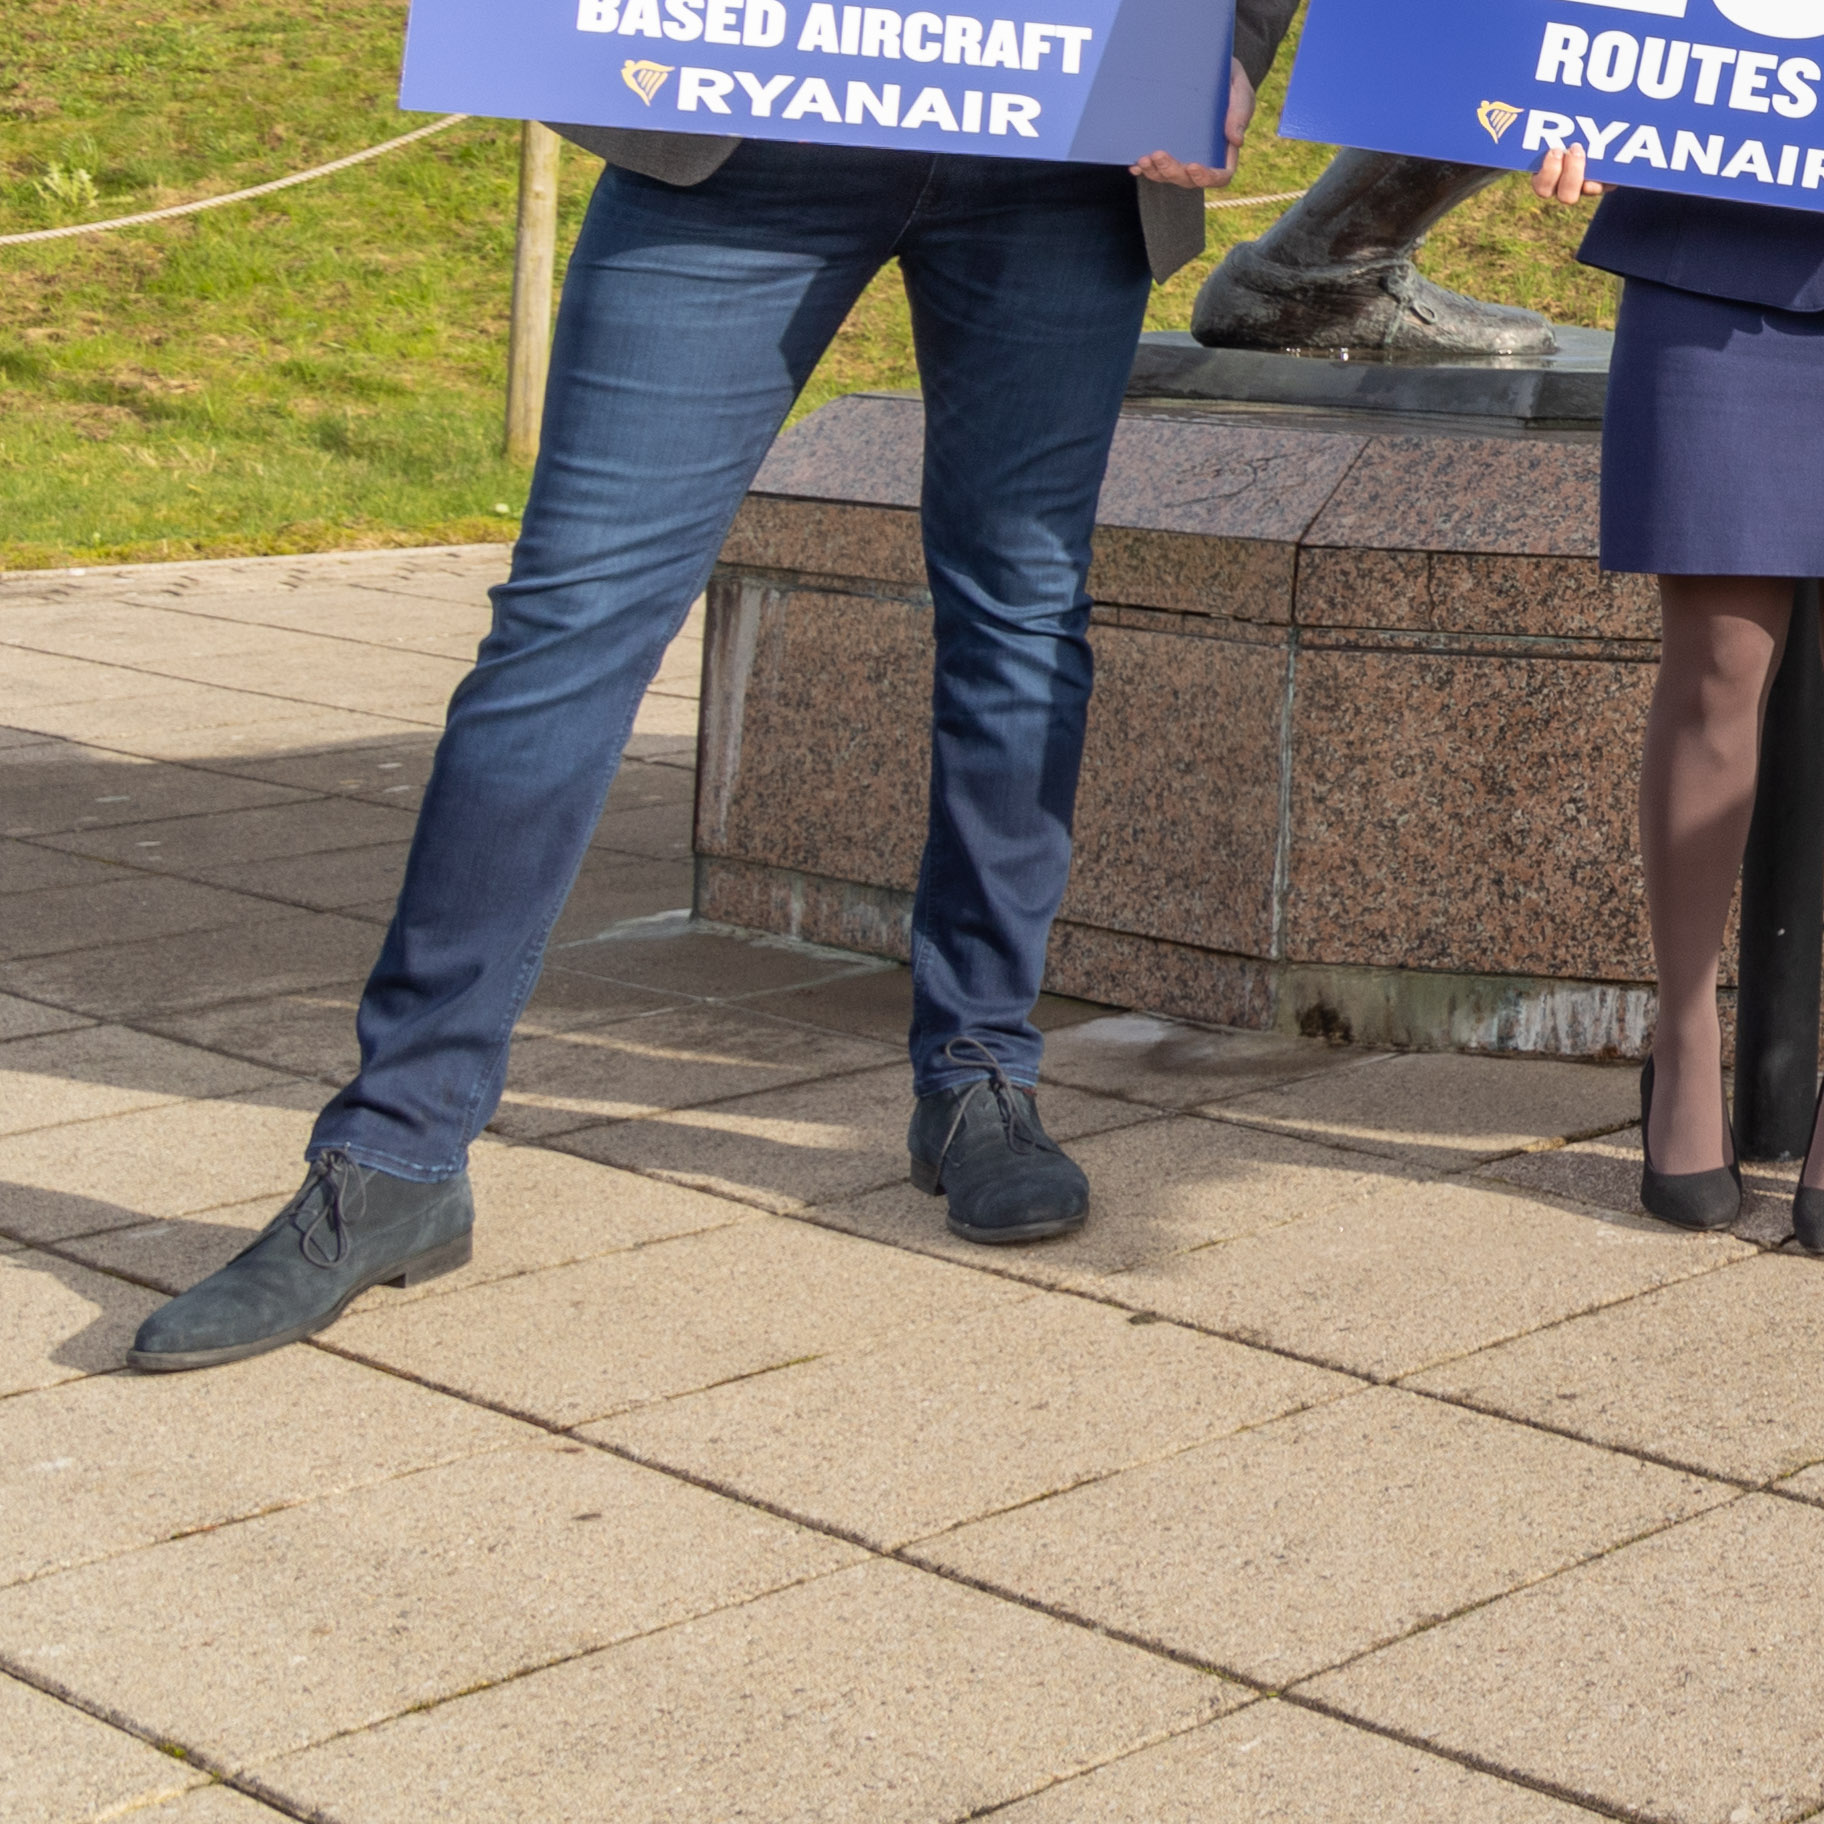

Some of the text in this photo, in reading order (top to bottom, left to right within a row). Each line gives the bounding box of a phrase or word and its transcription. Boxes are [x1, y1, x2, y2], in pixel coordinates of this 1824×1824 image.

[798, 4, 1092, 75] AIRCRAFT
[1535, 21, 1821, 118] ROUTES
[676, 66, 1042, 137] RYANAIR
